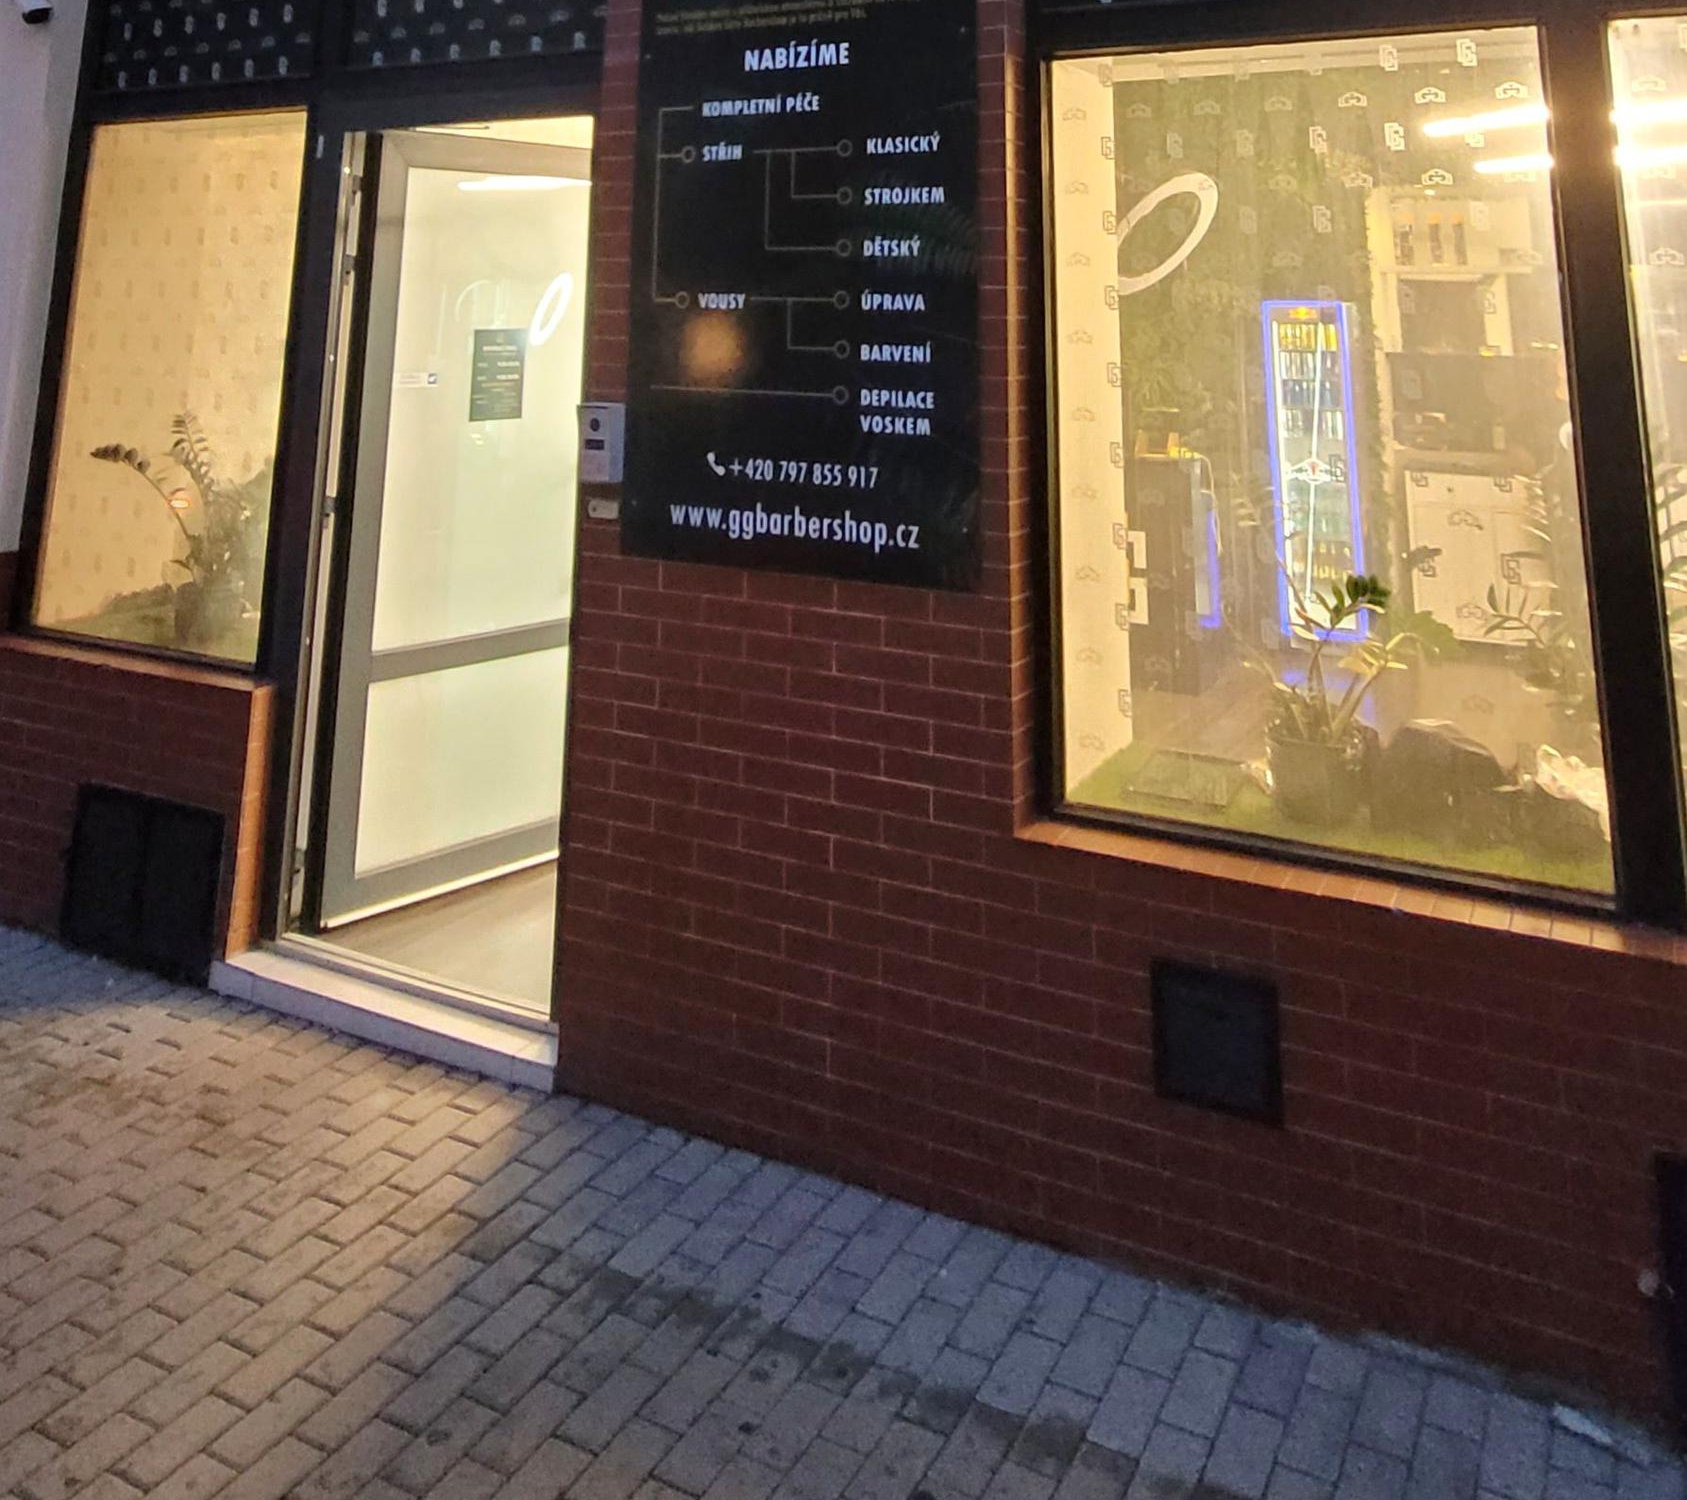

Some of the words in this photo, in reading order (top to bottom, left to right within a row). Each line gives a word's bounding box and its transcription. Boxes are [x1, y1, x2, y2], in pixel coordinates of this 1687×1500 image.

[744, 39, 850, 72] NABÍZÍME
[702, 94, 781, 117] KOMPLETNÍ
[786, 91, 820, 112] PÉČE
[702, 141, 743, 162] STŘIH
[867, 131, 941, 155] KLASICKÝ
[864, 186, 945, 206] STROJKEM
[863, 234, 921, 258] DĚTSKÝ
[698, 292, 746, 310] VOUSY
[861, 289, 926, 311] ÚPRAVA
[860, 341, 932, 364] BARVENÍ
[860, 389, 935, 410] DEPILACE
[860, 414, 931, 437] VOSKEM
[728, 457, 774, 482] +420
[779, 461, 808, 484] 797
[813, 464, 842, 487] 855
[848, 465, 879, 489] 917
[670, 502, 921, 554] www.ggbarbershop.cz
